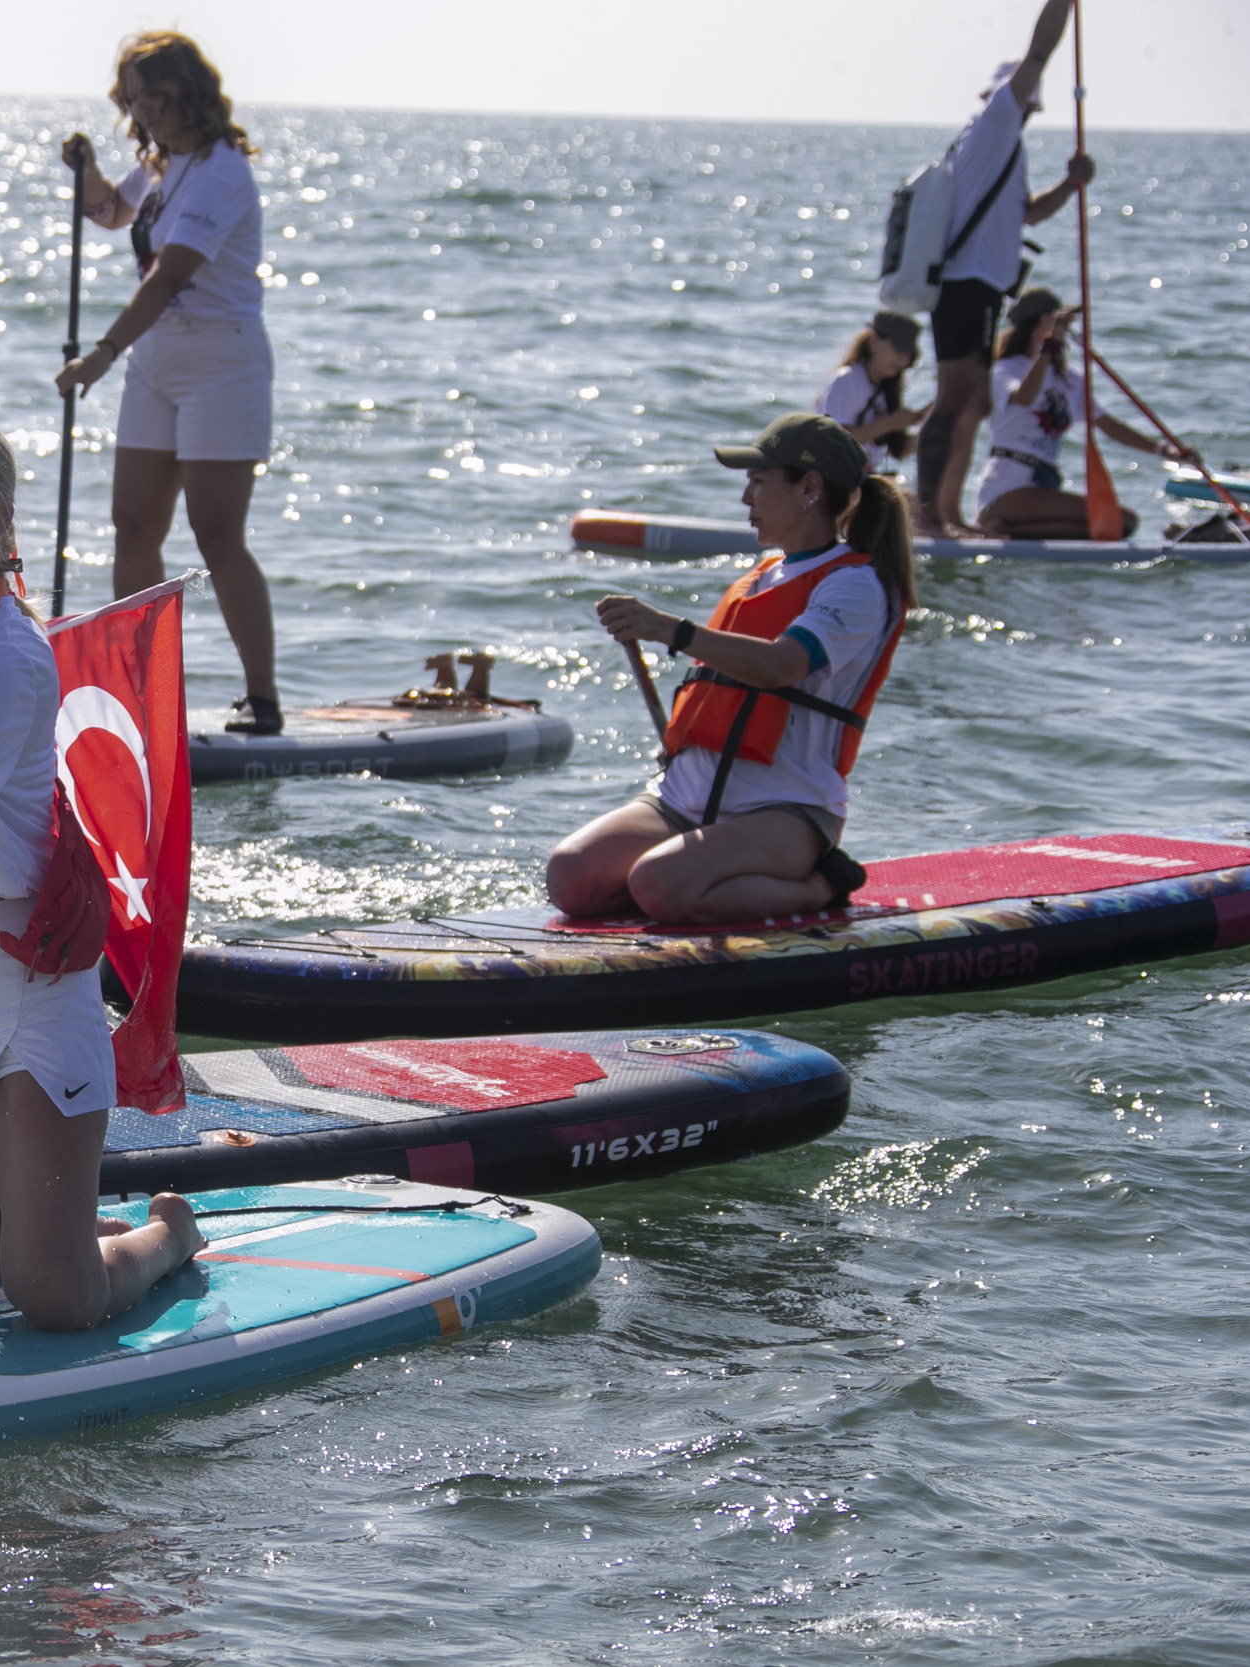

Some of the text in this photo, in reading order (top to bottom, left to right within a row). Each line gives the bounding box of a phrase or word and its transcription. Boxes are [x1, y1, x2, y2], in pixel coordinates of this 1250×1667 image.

[849, 941, 1040, 995] SKATINGER
[570, 1119, 719, 1169] 11'6X32"
[77, 1406, 130, 1433] ITIWIT
